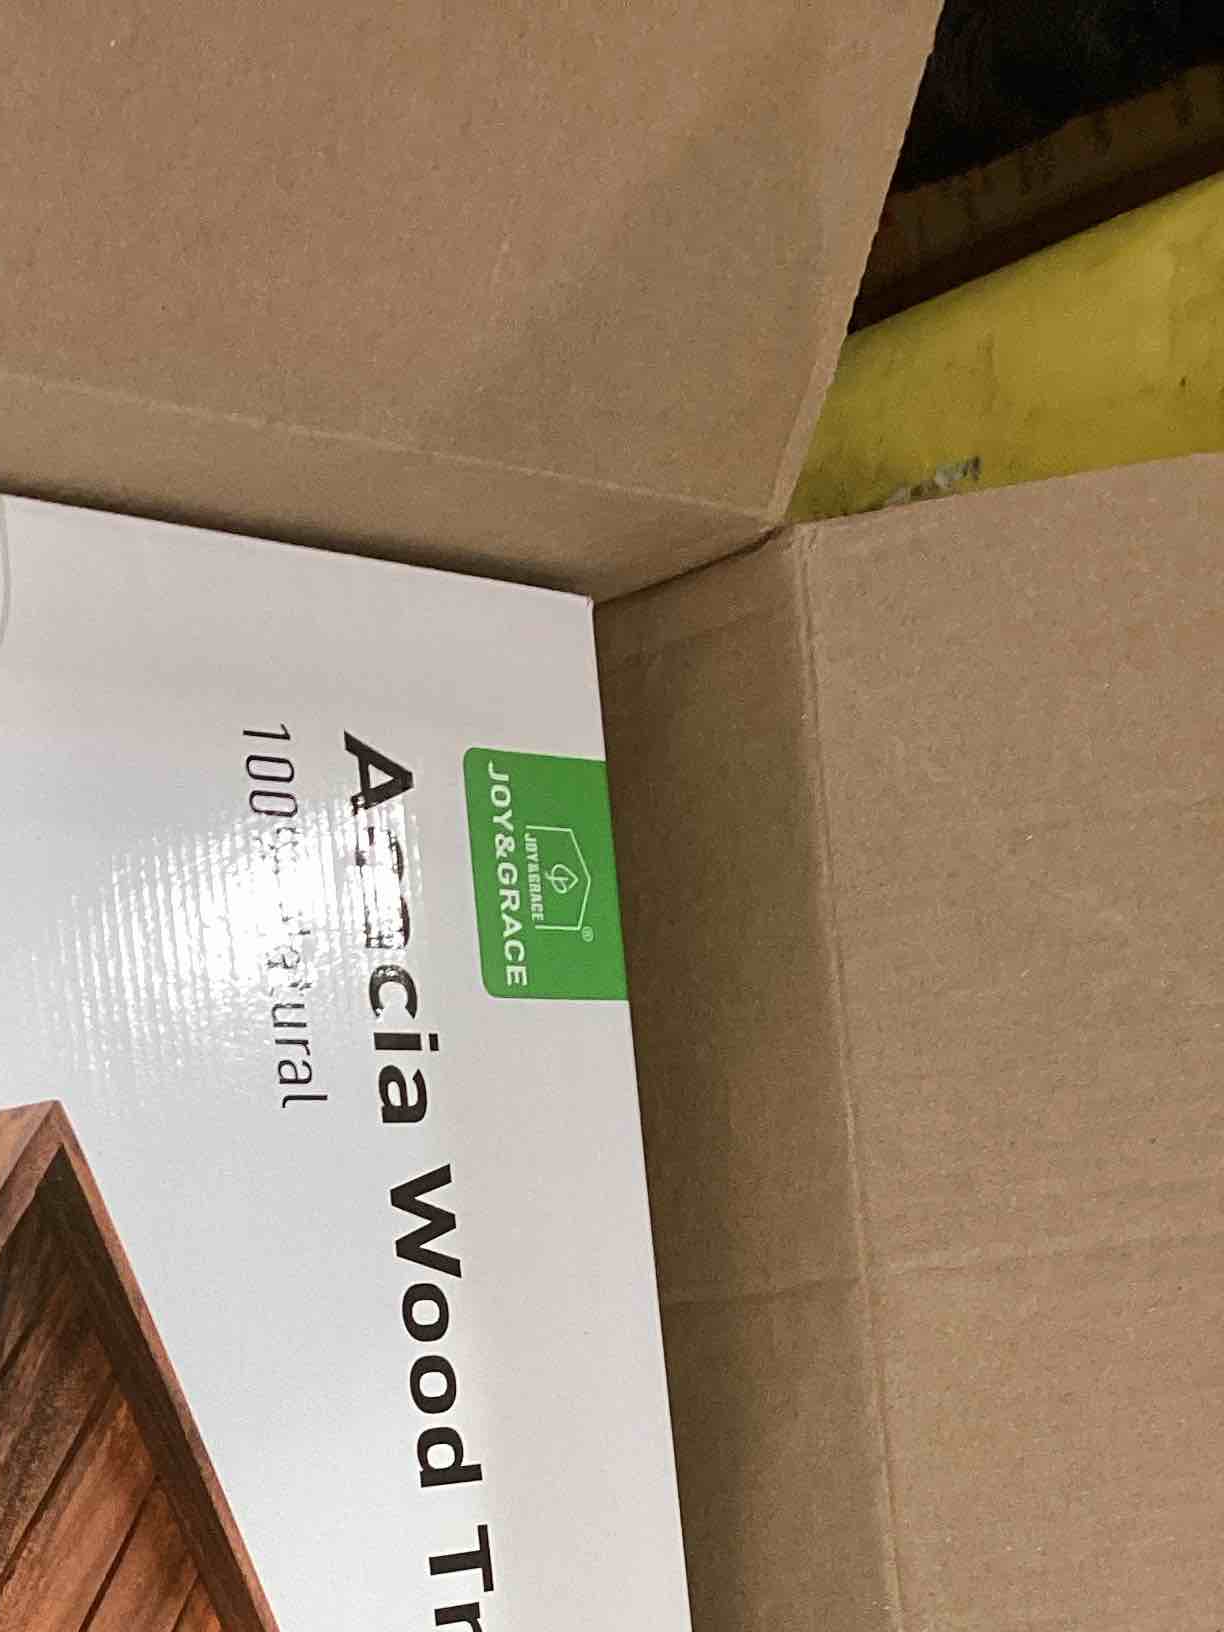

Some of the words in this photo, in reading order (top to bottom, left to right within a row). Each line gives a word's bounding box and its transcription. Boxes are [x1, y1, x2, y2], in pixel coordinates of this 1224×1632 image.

[242, 721, 300, 876] 100
[488, 761, 527, 987] JOY&GRACE
[388, 1163, 482, 1487] Wood
